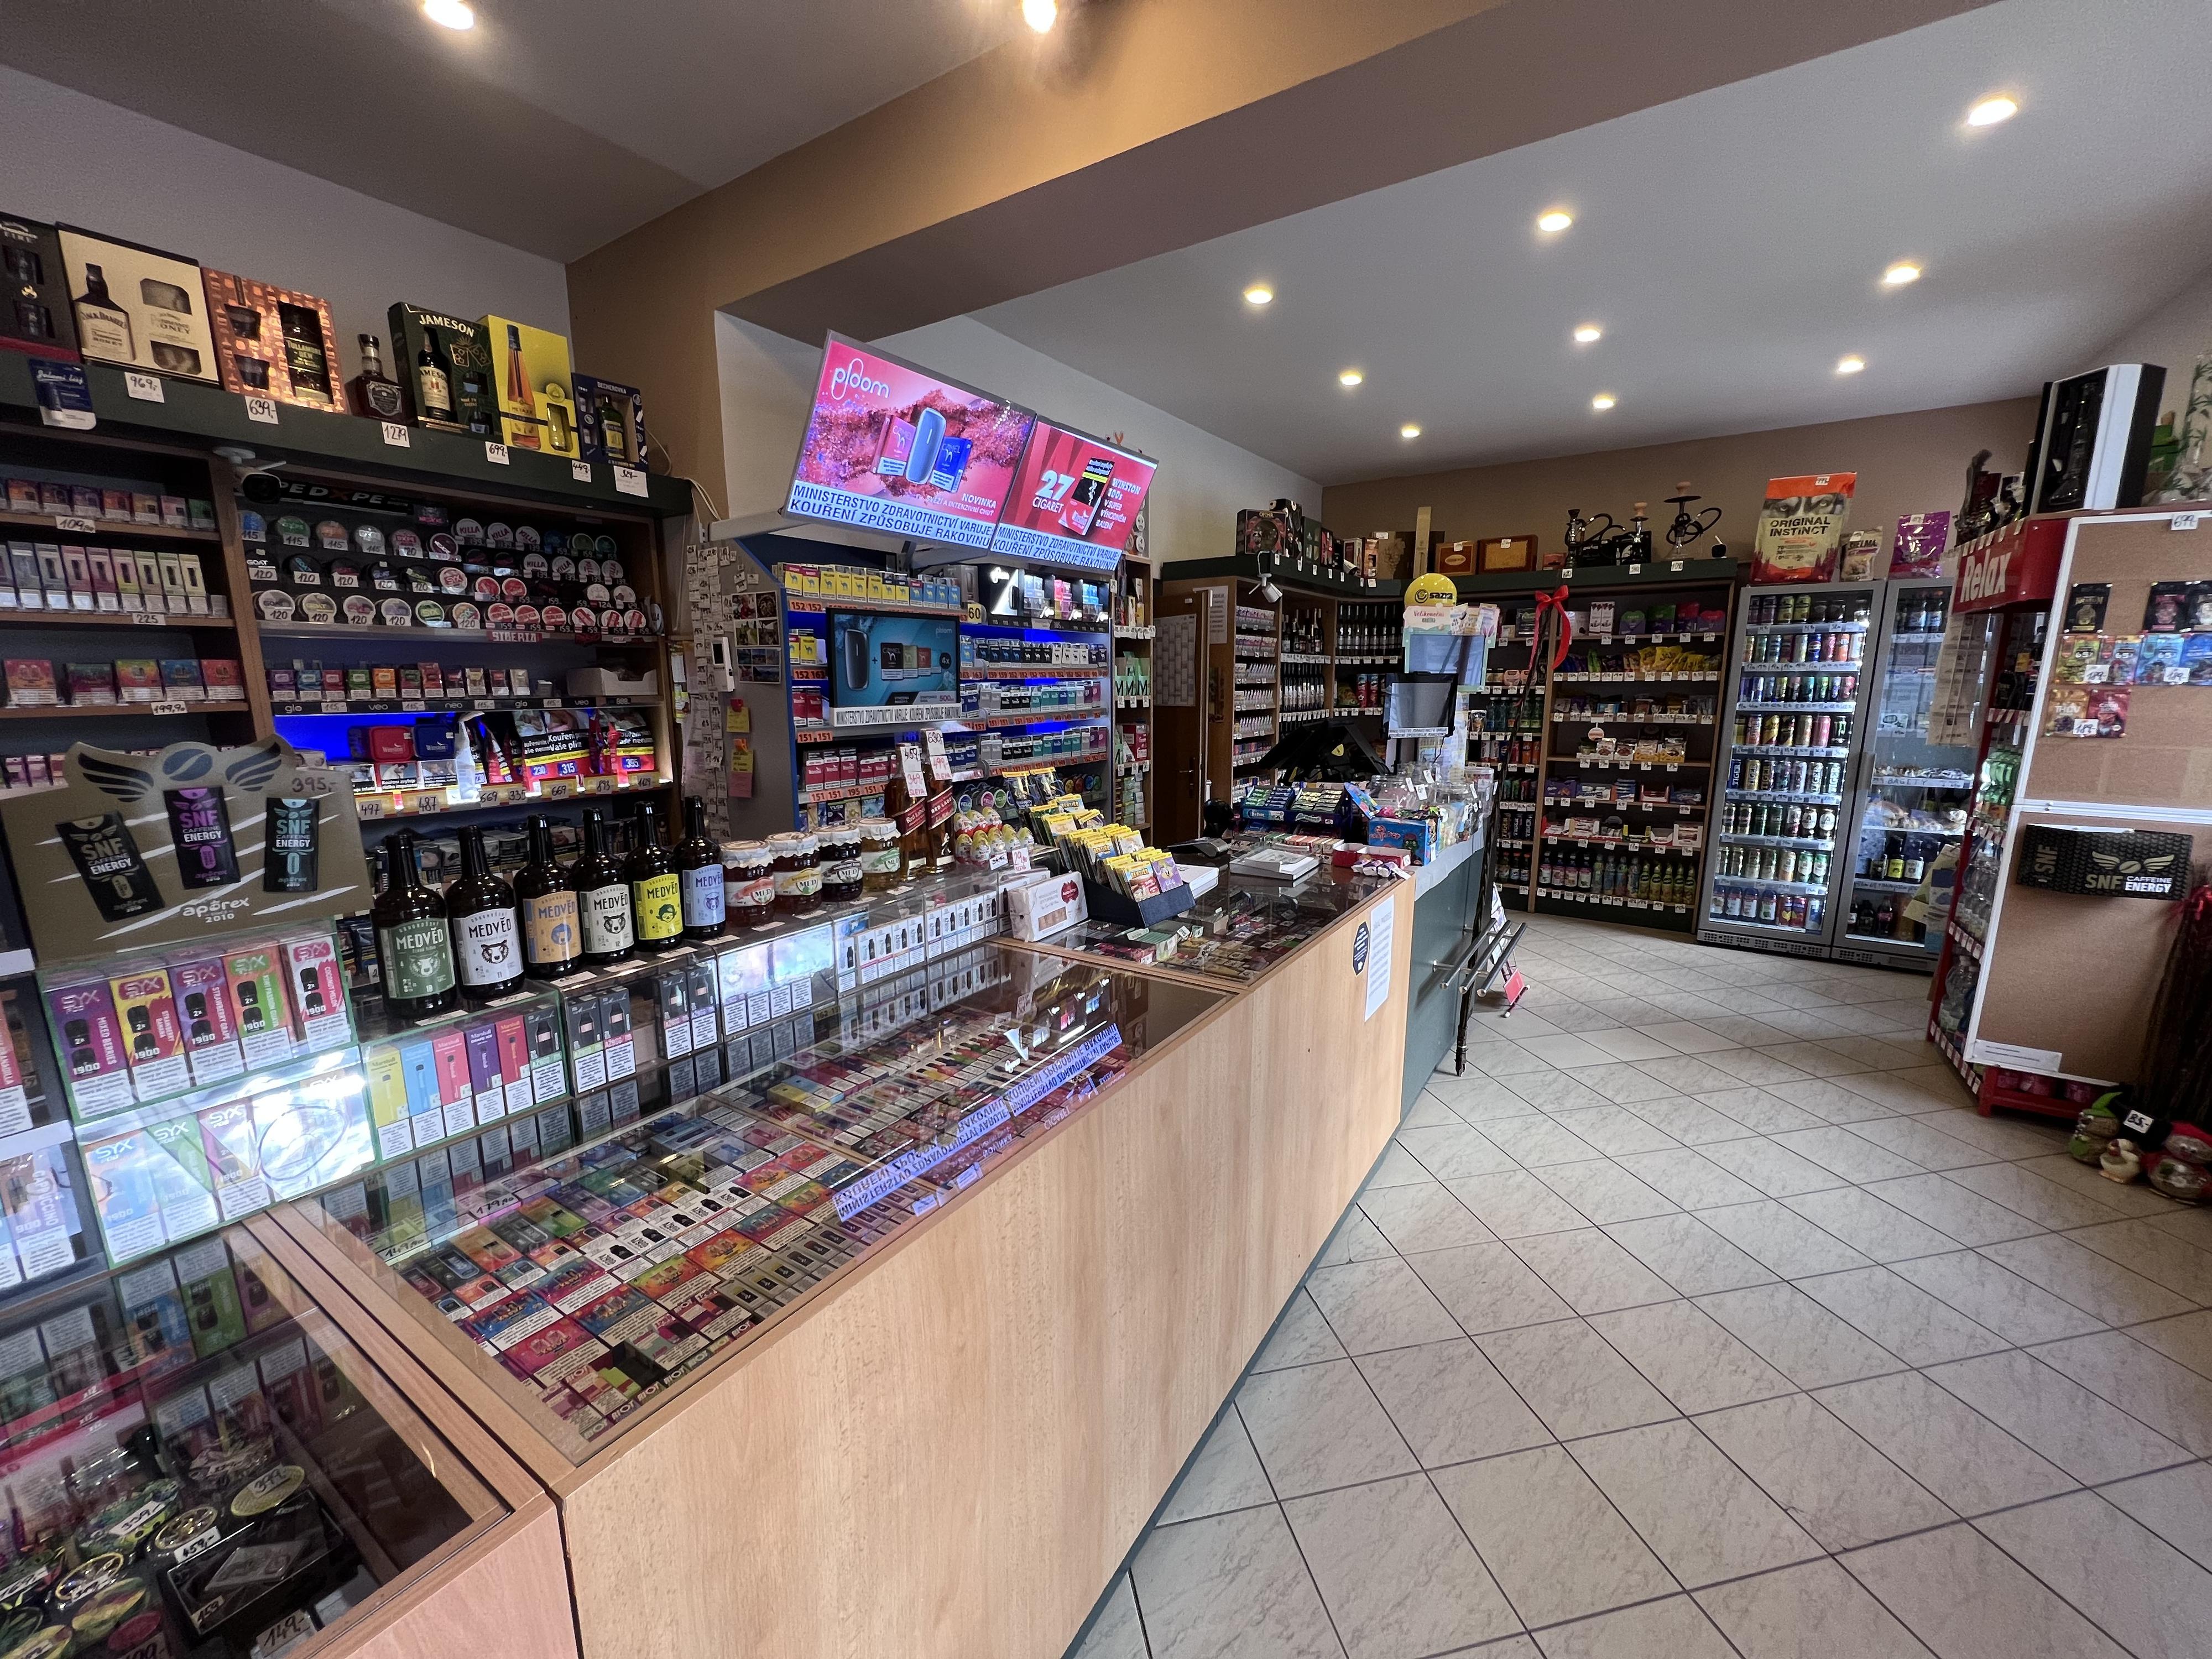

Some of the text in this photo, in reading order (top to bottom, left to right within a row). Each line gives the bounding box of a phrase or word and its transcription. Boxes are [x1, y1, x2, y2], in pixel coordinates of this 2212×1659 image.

[419, 315, 474, 337] JAMESON
[831, 358, 890, 400] ploom
[597, 382, 627, 394] BECHEROVKA
[1035, 470, 1076, 502] 27
[1112, 477, 1141, 495] WINSTON
[962, 493, 997, 510] NOVINKA
[1032, 497, 1064, 514] CIGARET
[794, 484, 993, 536] MINISTERSTVO ZDRAVOTNICTVÍ VARUJE:
[791, 498, 990, 547] KOUŘENÍ ZPŮSOBUJE RAKOVINU
[1770, 517, 1831, 528] ORIGINAL
[491, 529, 509, 541] KILLA
[1770, 525, 1829, 537] INSTINCT
[286, 536, 303, 545] 115
[997, 526, 1048, 546] MINISTERSTVO
[1049, 537, 1098, 556] ZDRAVOTNICTVÍ
[994, 539, 1032, 556] KOUŘENÍ
[1036, 547, 1078, 564] ZPŮSOBUJE
[255, 570, 273, 578] 120
[1960, 546, 2011, 603] Relax
[337, 577, 353, 586] 120
[791, 601, 806, 610] 152
[808, 602, 822, 611] 152
[136, 614, 158, 624] 225
[270, 611, 288, 619] 120
[311, 613, 328, 622] 120
[969, 607, 980, 618] 60
[351, 615, 367, 624] 120
[493, 632, 536, 642] SIBERIA
[796, 670, 809, 679] 152
[811, 670, 825, 679] 163
[285, 704, 302, 714] glo
[515, 700, 528, 709] glo
[548, 734, 575, 742] Kouření
[799, 733, 812, 742] 151
[817, 733, 831, 741] 151
[562, 763, 576, 773] 315
[625, 759, 639, 768] 395
[1732, 764, 1741, 786] TIGER
[1749, 764, 1757, 785] TIGER
[1887, 778, 1927, 786] BAGETY
[552, 785, 567, 796] 669
[828, 791, 842, 799] 151
[848, 787, 860, 796] 195
[864, 785, 877, 793] 151
[481, 792, 498, 802] 669
[811, 792, 825, 801] 151
[362, 803, 380, 814] 497
[420, 797, 436, 811] 487
[931, 805, 941, 814] RED
[179, 810, 217, 828] SNF
[276, 820, 311, 834] SNF
[184, 831, 222, 843] ENERGY
[81, 838, 124, 860] SNF
[88, 853, 131, 866] CAFFEINE
[2037, 844, 2058, 875] SNF
[91, 858, 132, 875] ENERGY
[2086, 874, 2124, 890] SNF
[2127, 875, 2172, 884] CAFFEINE
[2125, 881, 2172, 894] ENERGY
[594, 892, 628, 911] MEDVĚD
[538, 899, 576, 920] MEDVĚD
[205, 913, 235, 924] 2010
[469, 917, 512, 938] MEDVĚD
[396, 927, 443, 950] MEDVĚD
[298, 943, 326, 958] SYX
[235, 955, 267, 971] SYX
[182, 966, 216, 983] SYX
[124, 977, 160, 994] SYX
[61, 990, 100, 1008] SYX
[306, 1005, 327, 1015] 1900
[243, 1020, 266, 1031] 1900
[192, 1034, 216, 1045] 1900
[471, 1029, 492, 1038] Marshall
[97, 1016, 117, 1065] MIXED BERRIES
[134, 1047, 160, 1060] 1900
[74, 1062, 100, 1075] 1900
[210, 1104, 245, 1123] SYX
[155, 1121, 190, 1140] SYX
[96, 1139, 135, 1159] SYX
[732, 1321, 750, 1337] RIOT
[687, 1351, 709, 1368] RIOT
[565, 1365, 589, 1383] RIOT
[663, 1366, 686, 1384] RIOT
[637, 1383, 661, 1401] RIOT
[612, 1399, 635, 1420] RIOT
